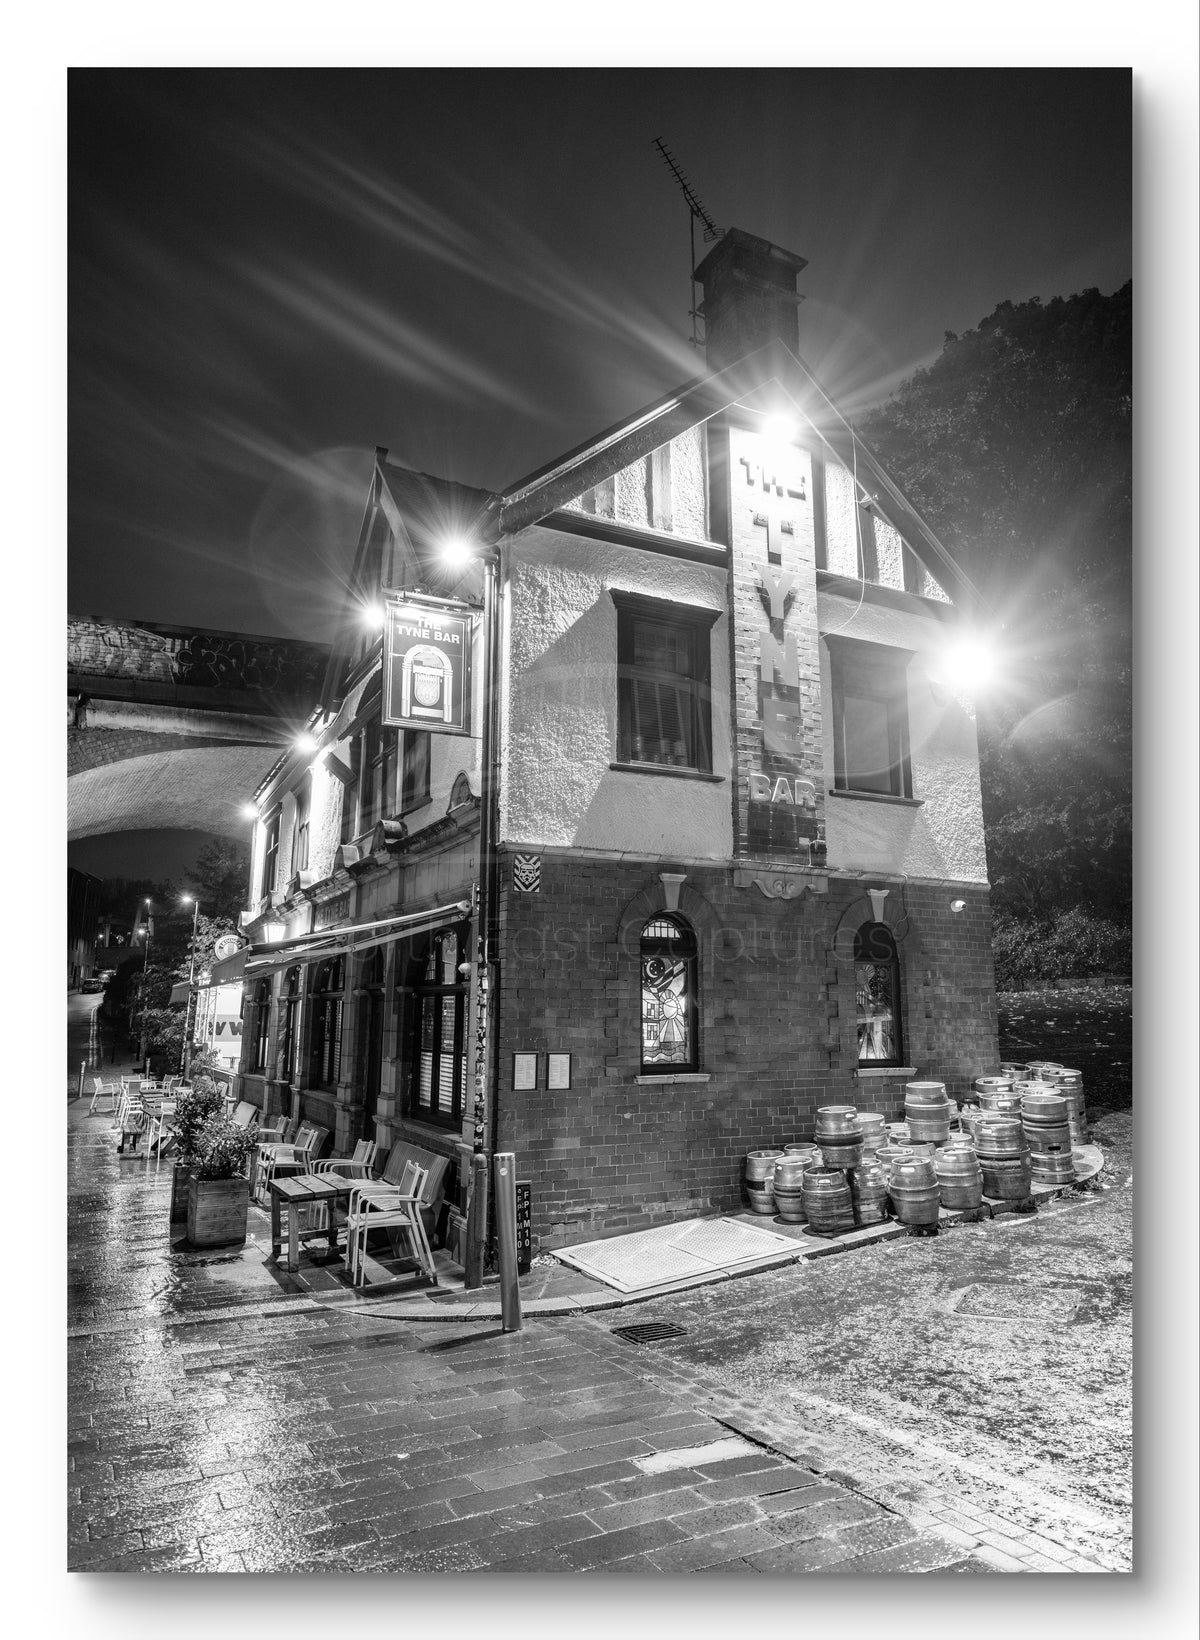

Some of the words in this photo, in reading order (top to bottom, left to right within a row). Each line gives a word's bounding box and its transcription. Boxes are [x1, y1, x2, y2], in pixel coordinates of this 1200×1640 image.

[396, 624, 430, 639] TYNE
[434, 630, 460, 644] BAR
[416, 616, 442, 630] THE
[752, 508, 801, 754] TYNE
[749, 773, 815, 808] BAR
